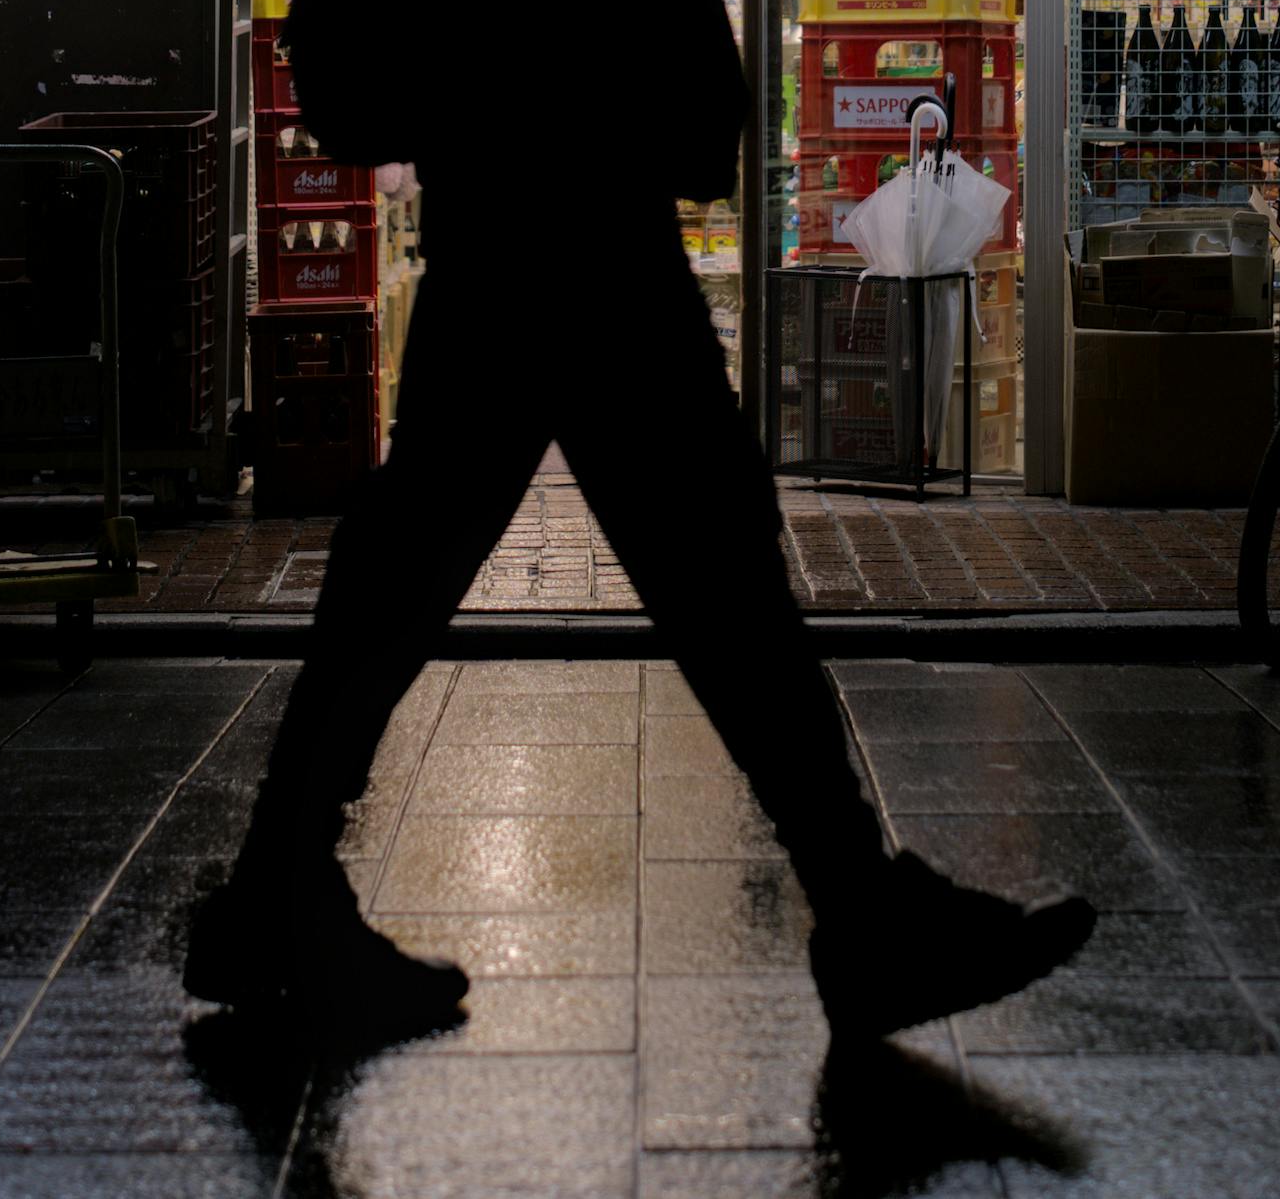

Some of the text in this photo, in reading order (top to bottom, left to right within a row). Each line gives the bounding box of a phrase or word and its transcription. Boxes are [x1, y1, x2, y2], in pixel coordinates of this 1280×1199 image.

[856, 98, 909, 113] SAPPO
[293, 168, 338, 189] Asahi
[296, 262, 340, 284] Asahi
